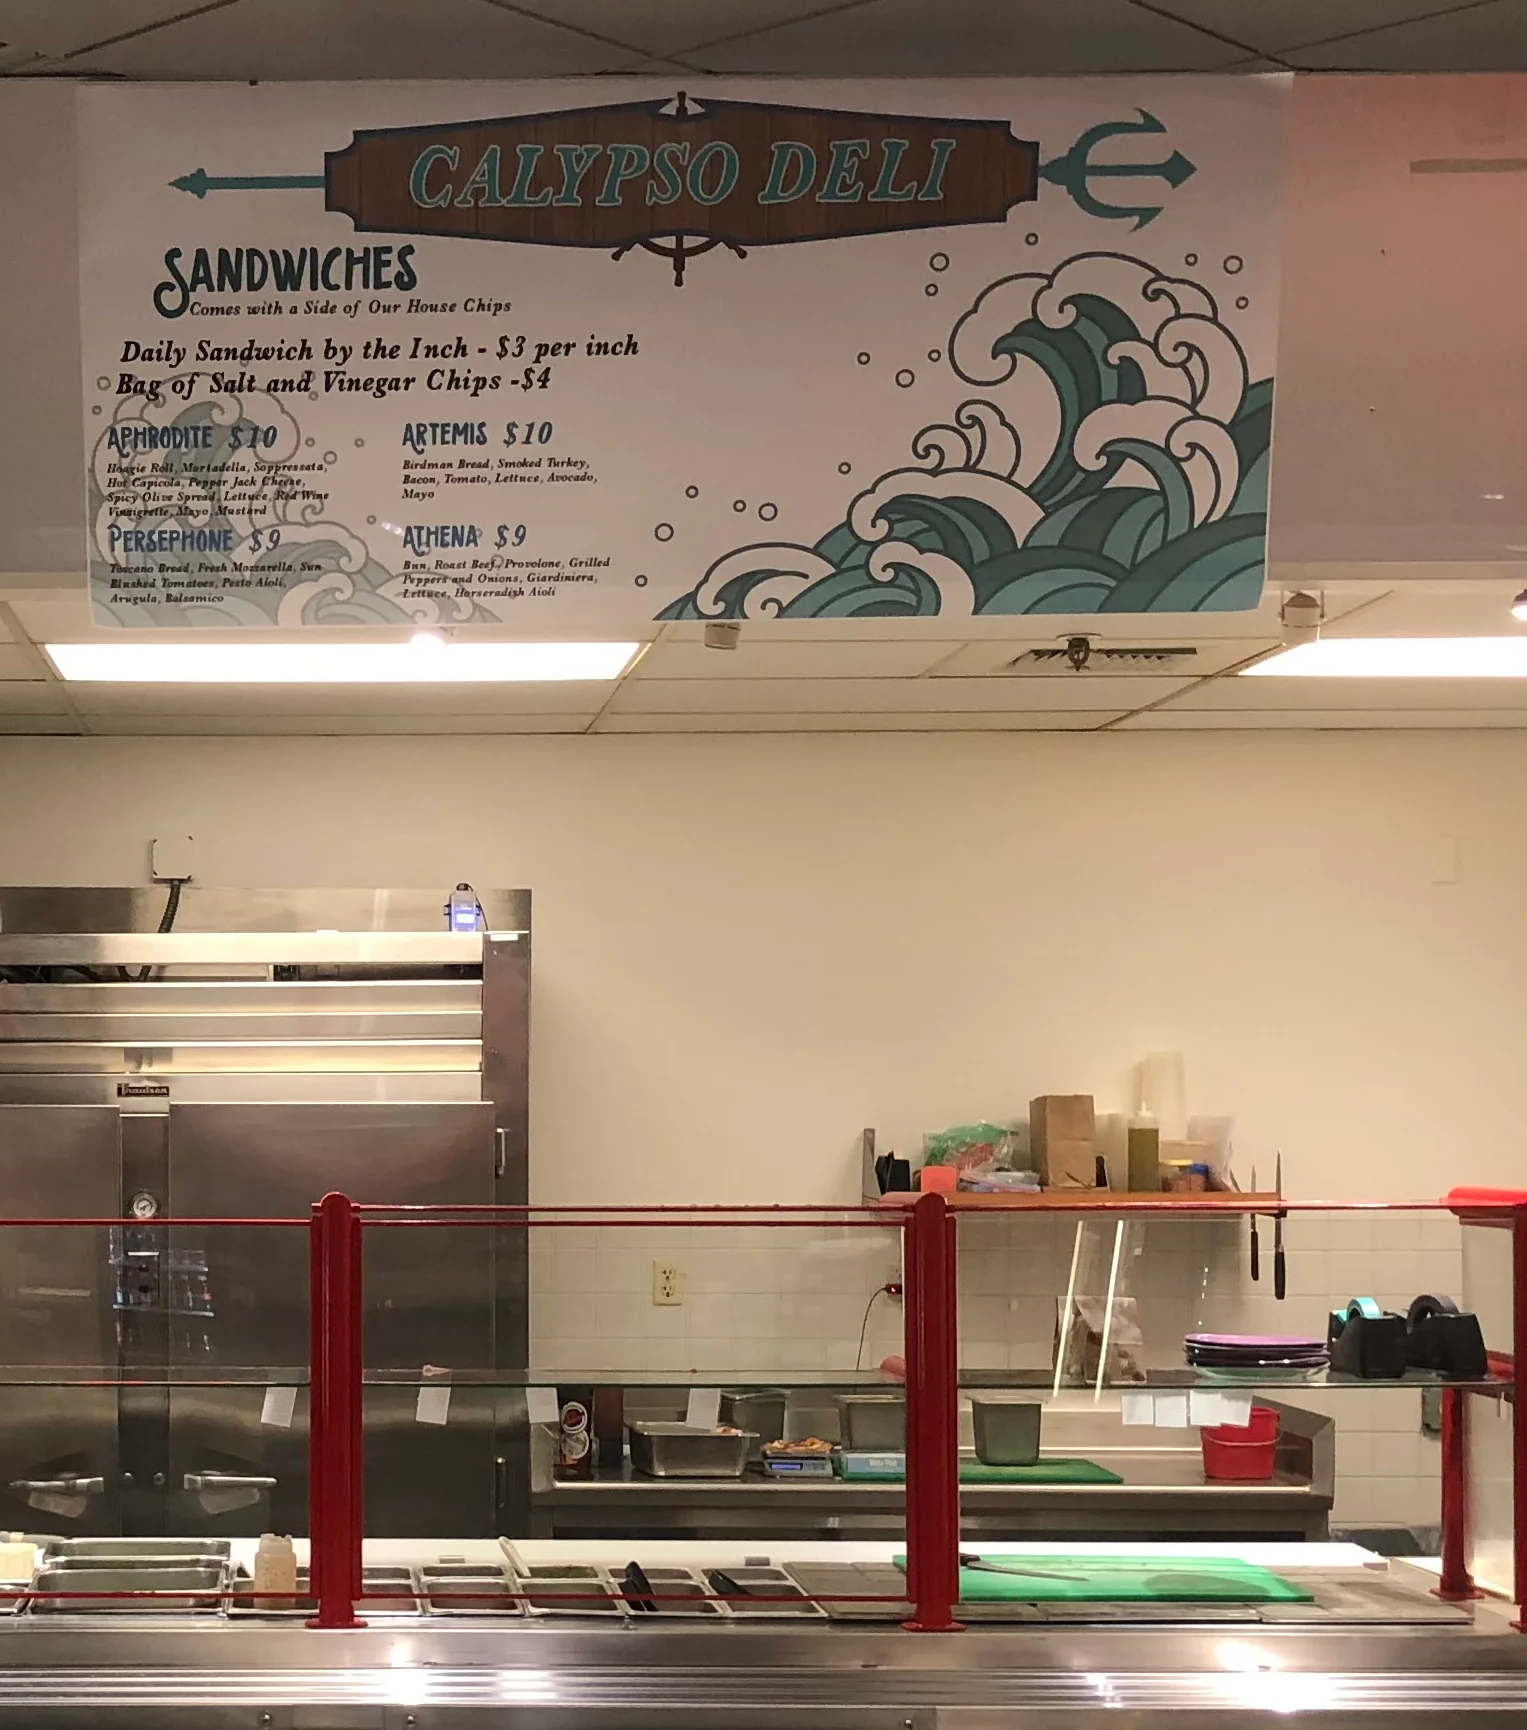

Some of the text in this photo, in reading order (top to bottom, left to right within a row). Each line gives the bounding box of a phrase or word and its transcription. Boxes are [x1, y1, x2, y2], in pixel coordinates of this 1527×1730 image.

[409, 138, 956, 208] CALYPSO DELI
[153, 244, 417, 319] SANDWICHES
[190, 297, 512, 318] Comes with a Side of Our House Chips
[120, 340, 187, 368] Daily
[195, 339, 314, 361] Sandwich
[323, 338, 353, 366] by
[362, 337, 401, 360] the
[409, 336, 469, 359] Inch
[496, 335, 526, 360] $3
[532, 340, 577, 364] per
[585, 334, 640, 357] inch
[116, 373, 162, 401] Bag
[171, 372, 200, 400] of
[209, 371, 257, 393] Salt
[266, 370, 312, 393] and
[323, 370, 416, 398] Vinegar
[426, 368, 502, 397] Chips
[107, 425, 278, 458] APHRODITE $10
[402, 420, 553, 455] ARTEMIS $10
[107, 462, 327, 476] Hoagie Roll, Mortadella, Soppressata,
[402, 457, 590, 471] Birdman Bread, Smoked Turkey,
[107, 478, 129, 488] Hot
[131, 477, 185, 490] Capicola,
[188, 477, 228, 490] Pepper
[230, 476, 257, 488] Jack
[402, 472, 598, 486] Bacon, Tomato, Lettuce, Avocado,
[107, 492, 139, 505] Spicy
[142, 491, 174, 502] Olive
[224, 491, 271, 503] Lettuce,
[275, 491, 297, 501] Red
[301, 490, 330, 500] Wine
[401, 489, 435, 502] Mayo
[176, 507, 212, 518] Mayo,
[216, 506, 267, 517] Mustard
[107, 523, 281, 554] PERSEPHONE $9
[403, 524, 527, 557] ATHENA $9
[110, 563, 154, 574] Toscano
[158, 563, 194, 575] Bread,
[197, 563, 227, 573] Fresh
[300, 562, 322, 571] Sun
[403, 557, 611, 571] Bun, Roast Beef, Provolone, Grilled
[110, 577, 287, 589] Blushed Tomatoes, Pesto Aioli,
[403, 572, 598, 587] Peppers and Onions, Giardiniera,
[110, 593, 224, 606] Arugula, Balsamico
[403, 587, 556, 600] Lettuce, Horseradish Aioli
